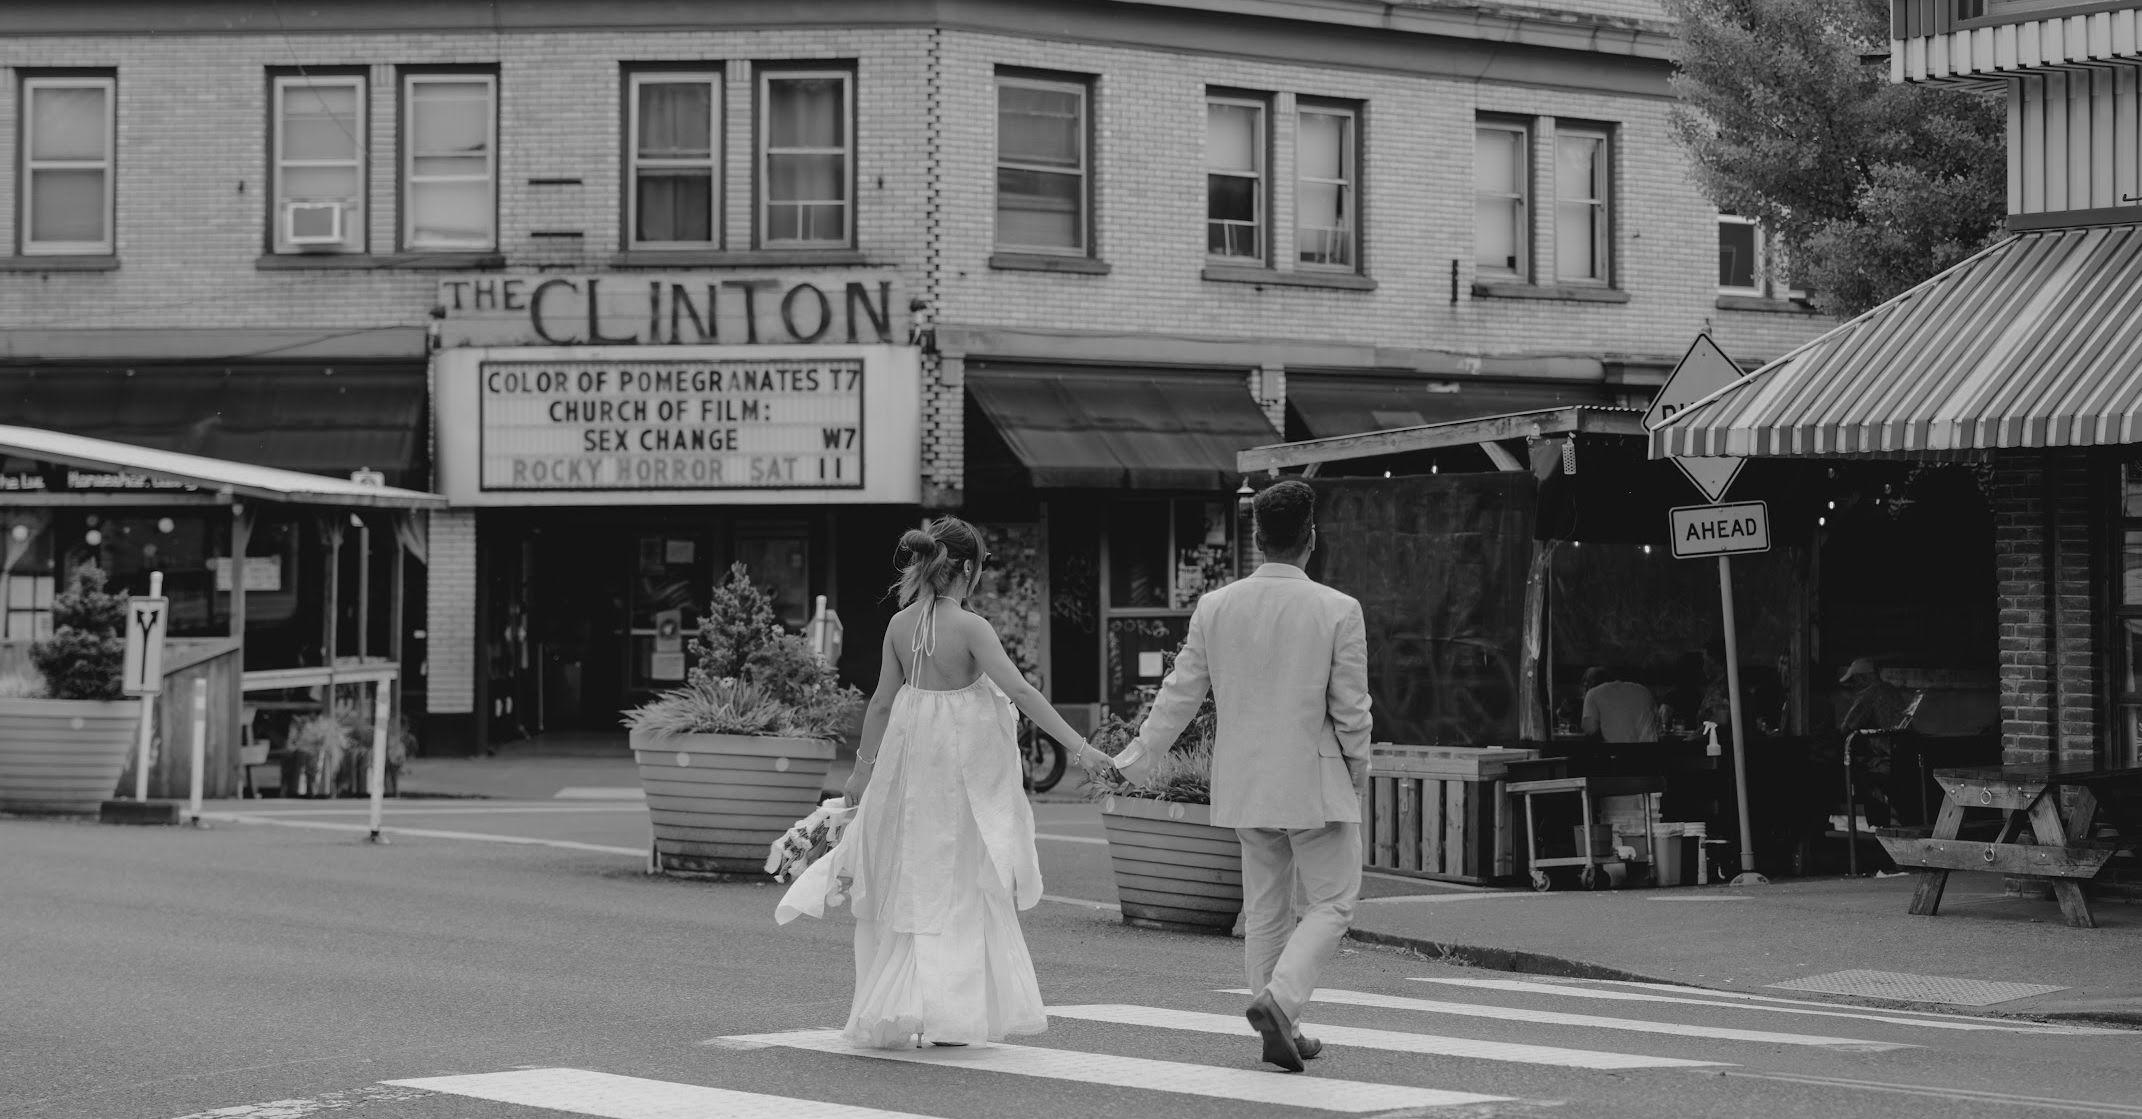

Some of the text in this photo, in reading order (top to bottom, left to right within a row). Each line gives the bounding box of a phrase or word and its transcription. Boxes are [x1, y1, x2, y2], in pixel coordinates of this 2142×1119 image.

[444, 278, 894, 346] THE CLINTON
[488, 368, 860, 393] COLOR OF POMEGRANATES T7
[549, 399, 771, 422] CHURCH OF FILM:
[583, 427, 857, 451] SEX CHANGE W7
[512, 459, 602, 482] ROCKY
[616, 458, 723, 481] HORROR
[751, 457, 799, 481] SAT
[1686, 518, 1757, 541] AHEAD
